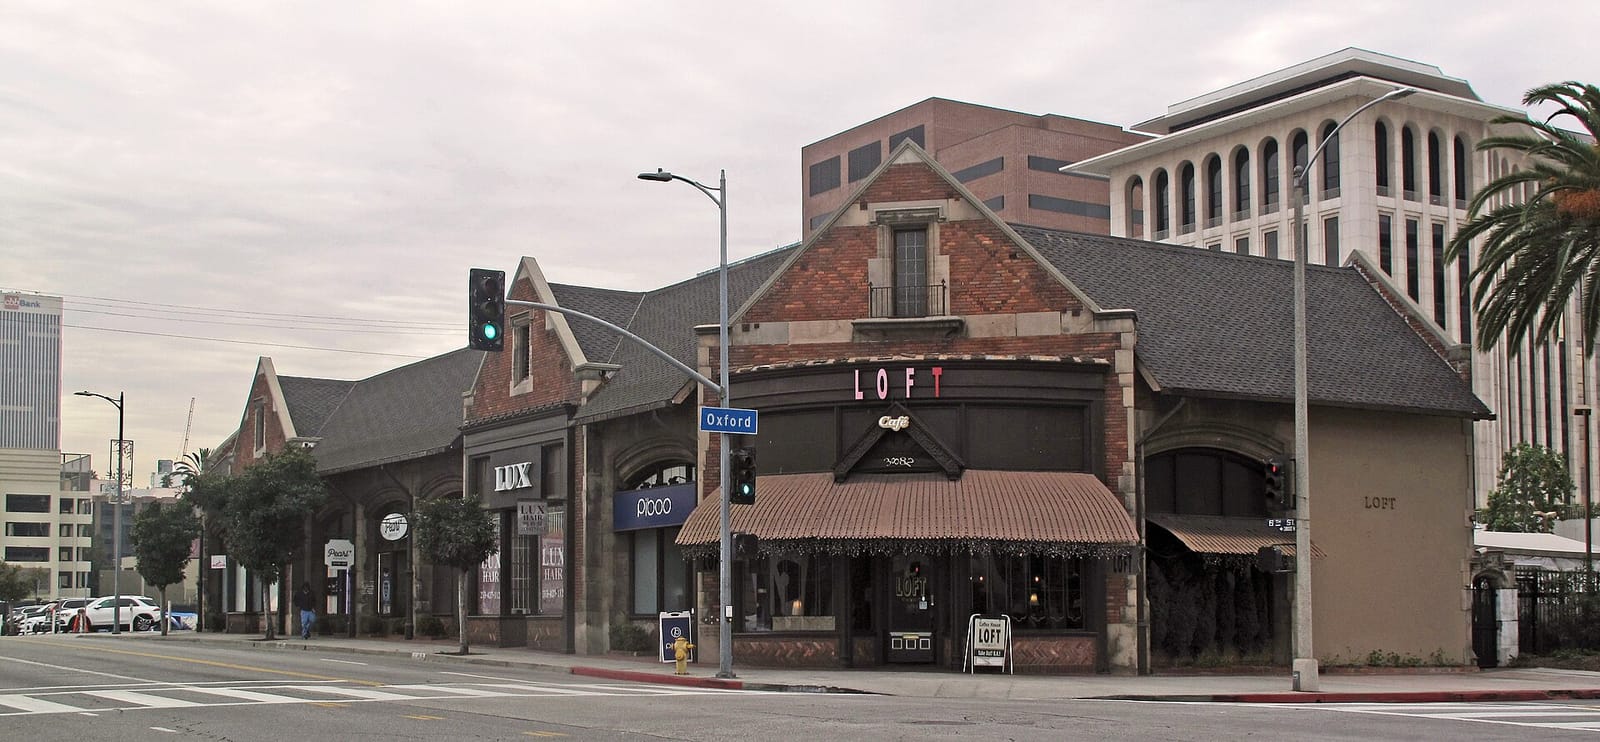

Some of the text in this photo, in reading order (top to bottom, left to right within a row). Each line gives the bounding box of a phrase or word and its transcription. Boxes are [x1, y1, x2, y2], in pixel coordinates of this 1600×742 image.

[854, 367, 943, 400] LOFT
[706, 413, 751, 428] Oxford
[878, 416, 909, 432] Café
[494, 461, 533, 492] LUX
[521, 505, 545, 514] LUX
[1364, 496, 1397, 510] LOFT
[542, 547, 564, 566] LUX
[1113, 553, 1132, 574] LOFT
[482, 570, 500, 583] HAIR
[544, 568, 563, 580] HAIR
[896, 577, 926, 597] LOFT
[978, 628, 1001, 643] LOFT
